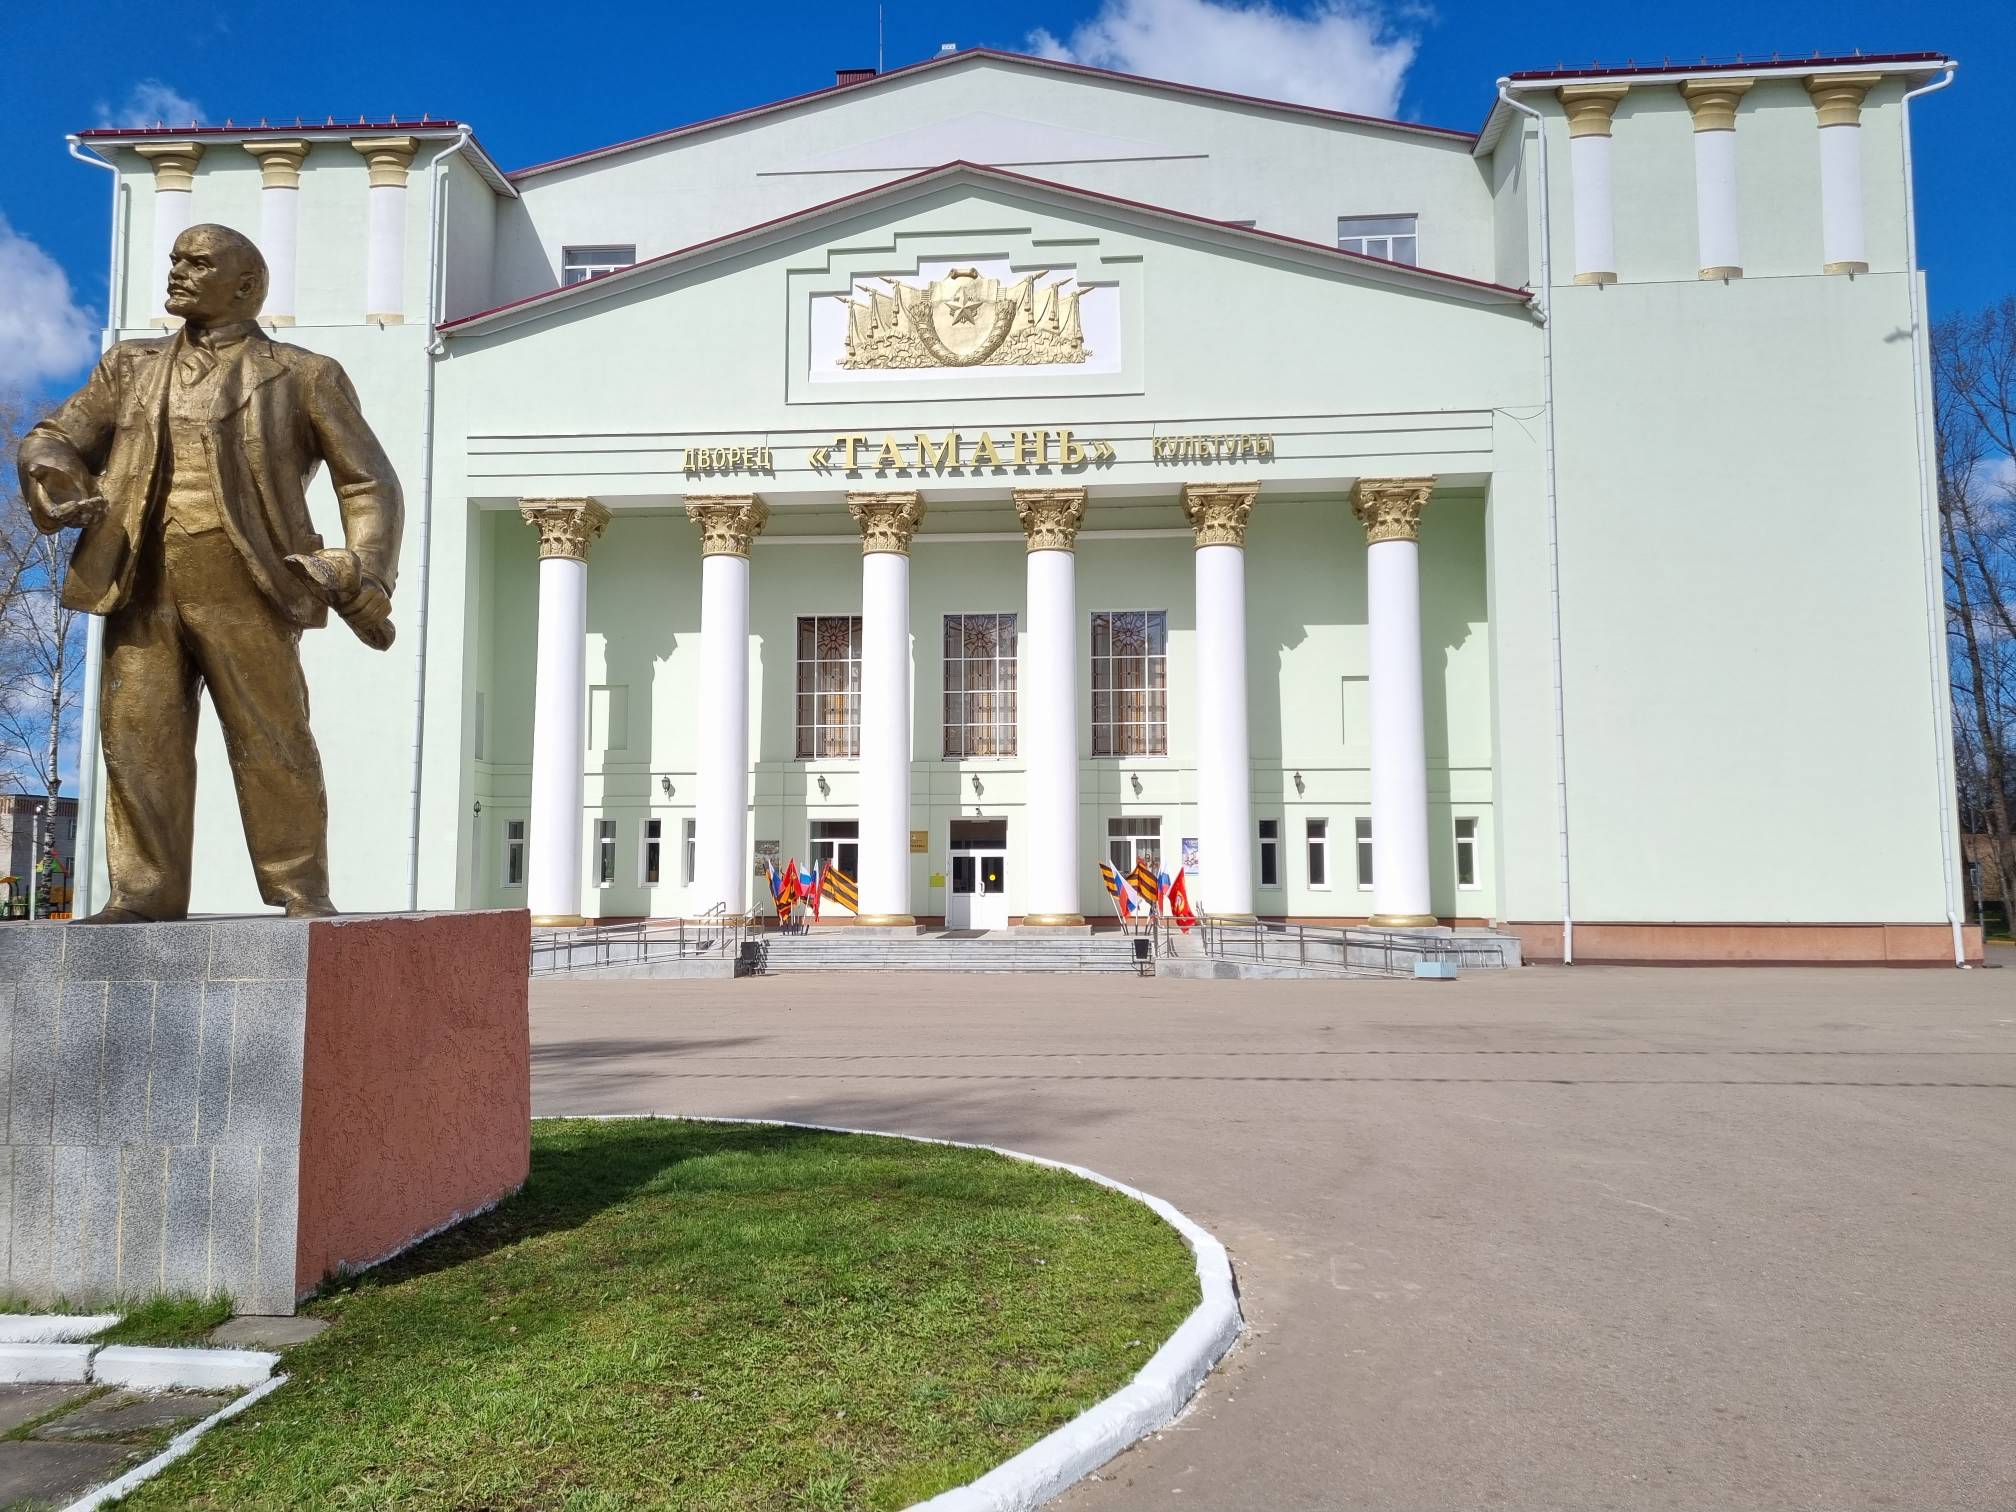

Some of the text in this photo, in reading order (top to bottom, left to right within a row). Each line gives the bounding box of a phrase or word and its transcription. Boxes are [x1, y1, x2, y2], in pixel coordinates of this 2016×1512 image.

[682, 429, 1273, 472] ДВОРЕЦ «ТАМАНЬ» КУЛЬТУРЫ
